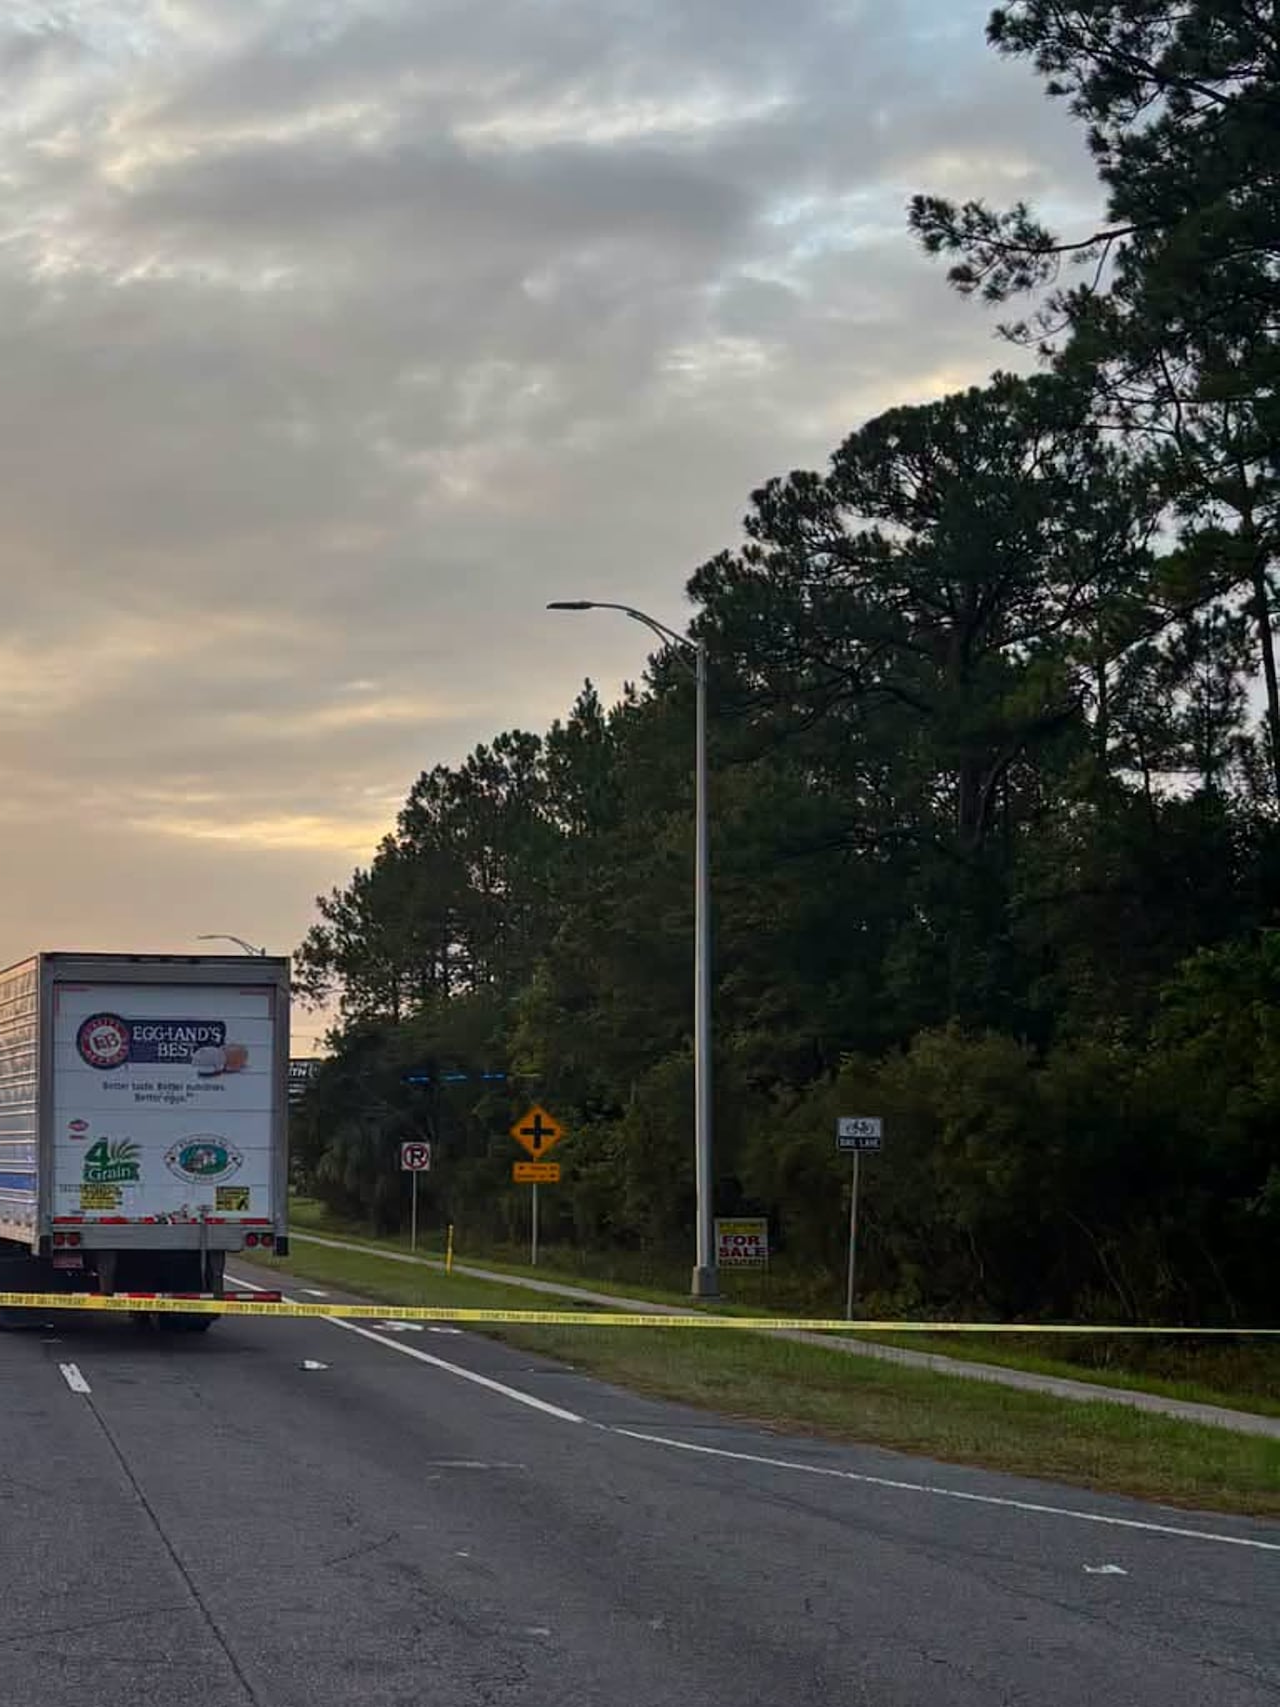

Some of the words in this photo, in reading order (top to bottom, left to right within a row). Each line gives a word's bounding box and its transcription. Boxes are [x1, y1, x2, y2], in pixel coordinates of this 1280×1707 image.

[158, 1042, 197, 1057] BEST
[84, 1136, 111, 1169] 4
[88, 1166, 131, 1181] Grain
[722, 1235, 761, 1245] FOR
[719, 1247, 767, 1257] SALE
